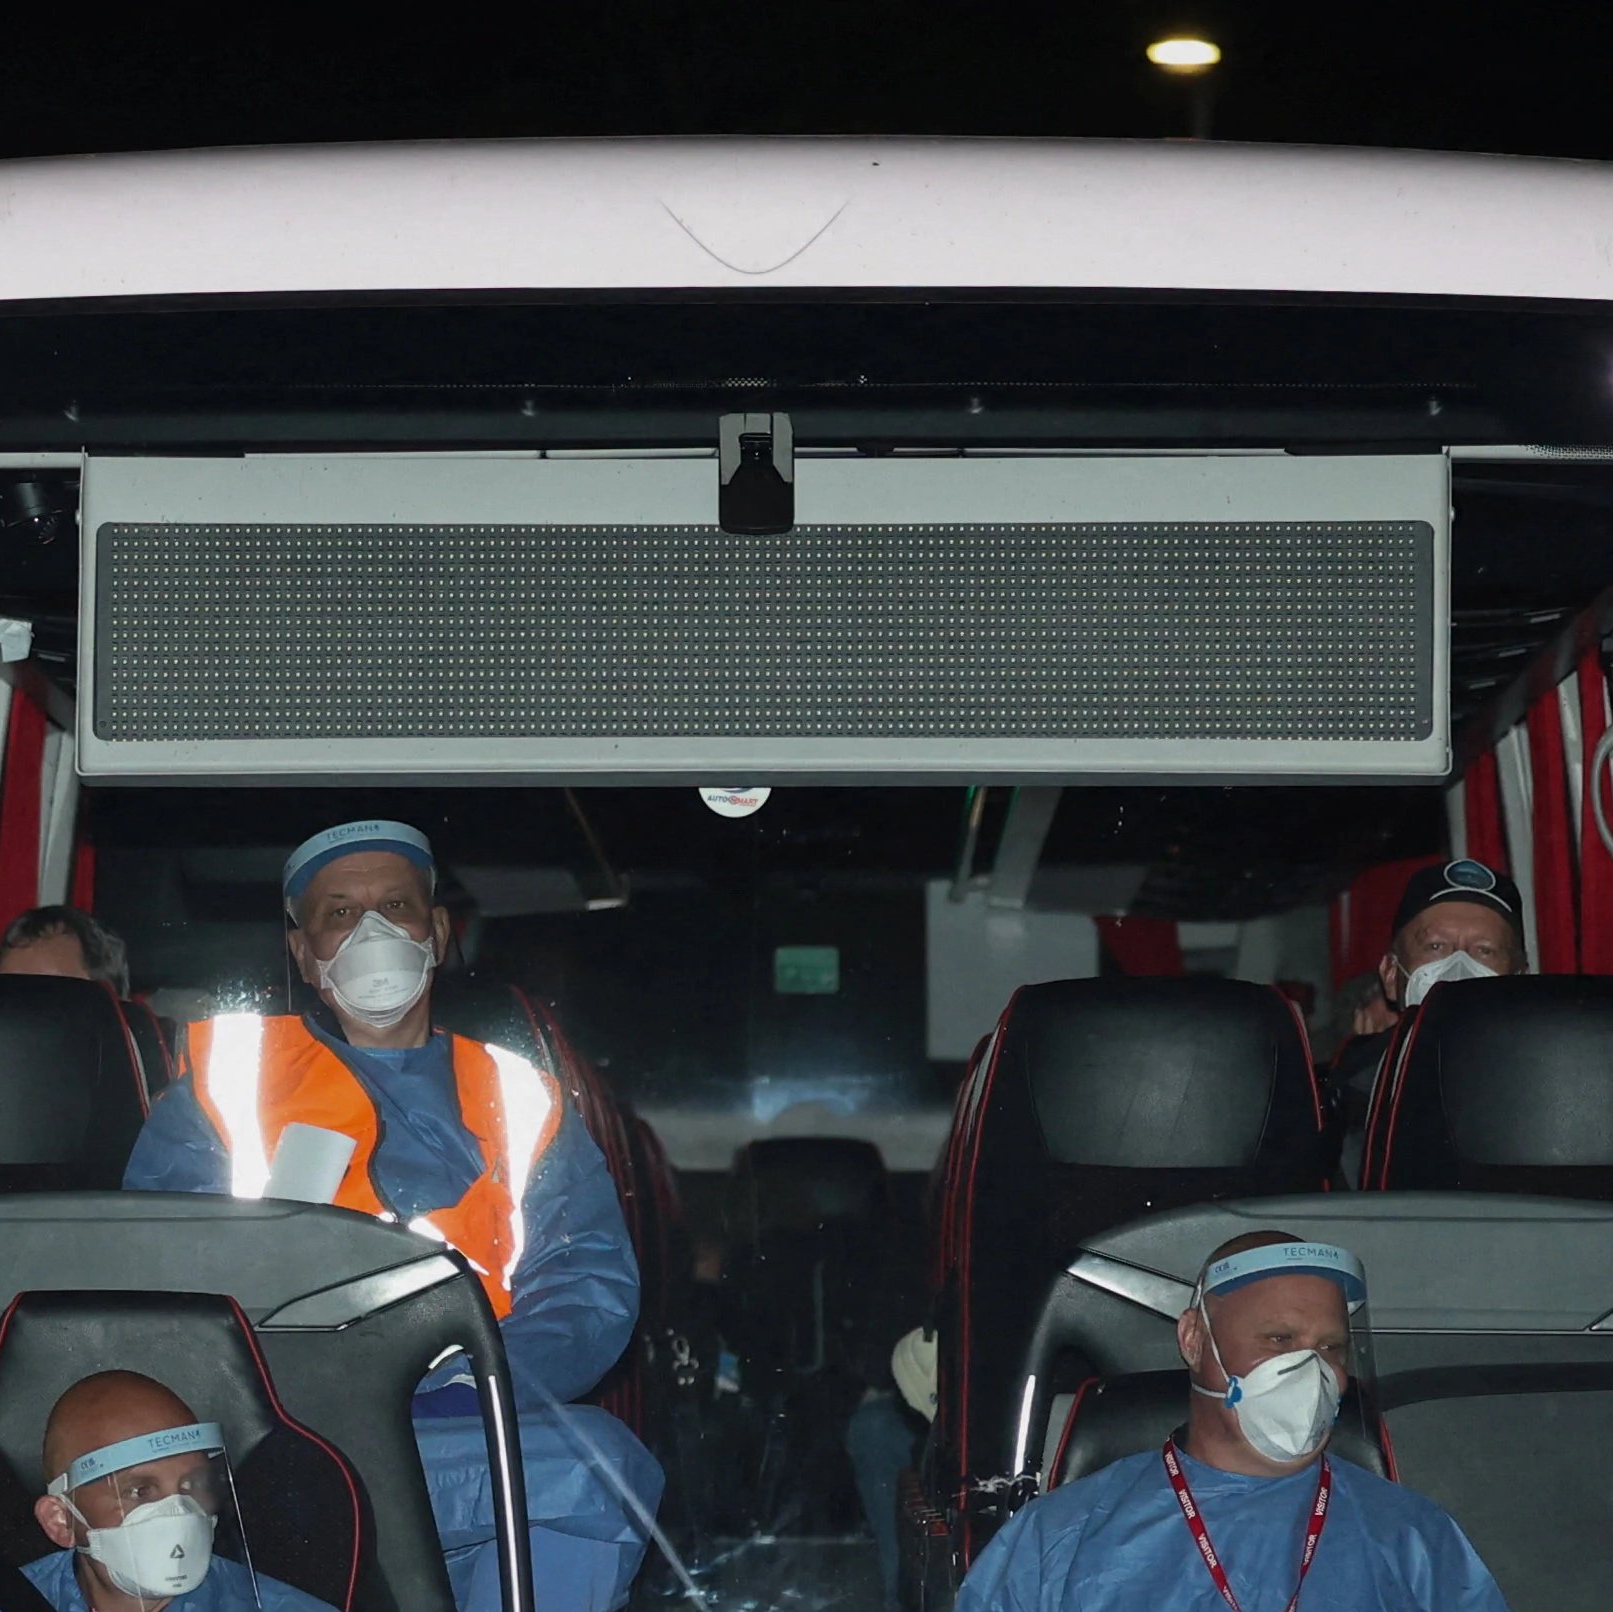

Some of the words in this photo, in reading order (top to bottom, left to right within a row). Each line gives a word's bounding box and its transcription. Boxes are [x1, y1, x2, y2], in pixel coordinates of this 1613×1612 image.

[1283, 1247, 1333, 1258] TECMAN
[148, 1430, 195, 1449] TECMAN
[1164, 1451, 1179, 1477] VISITOR
[1178, 1488, 1196, 1519] VISITOR
[1314, 1486, 1328, 1516] VISITOR
[1198, 1532, 1217, 1569] VISITOR
